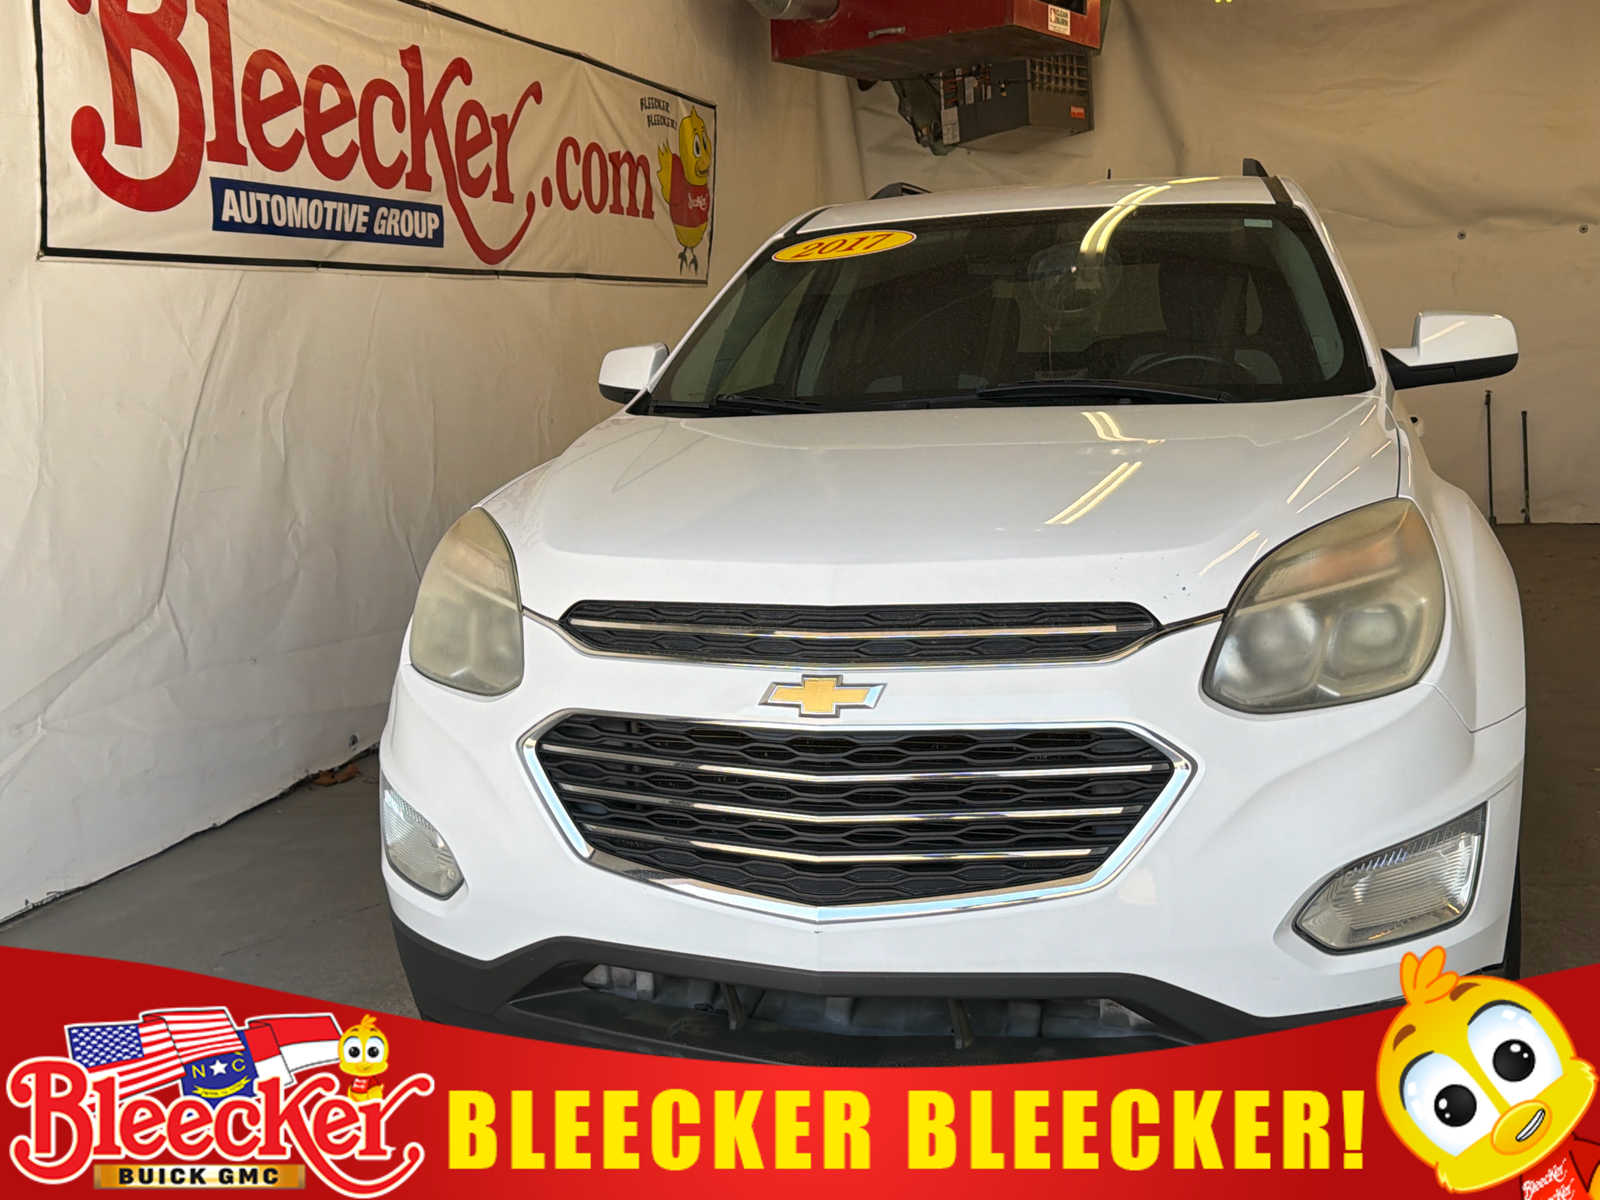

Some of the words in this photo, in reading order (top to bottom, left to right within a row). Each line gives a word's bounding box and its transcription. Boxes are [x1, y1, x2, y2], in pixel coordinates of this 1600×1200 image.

[221, 188, 370, 233] AUTOMOTIVE
[373, 206, 440, 239] GROUP
[791, 233, 895, 258] 2017
